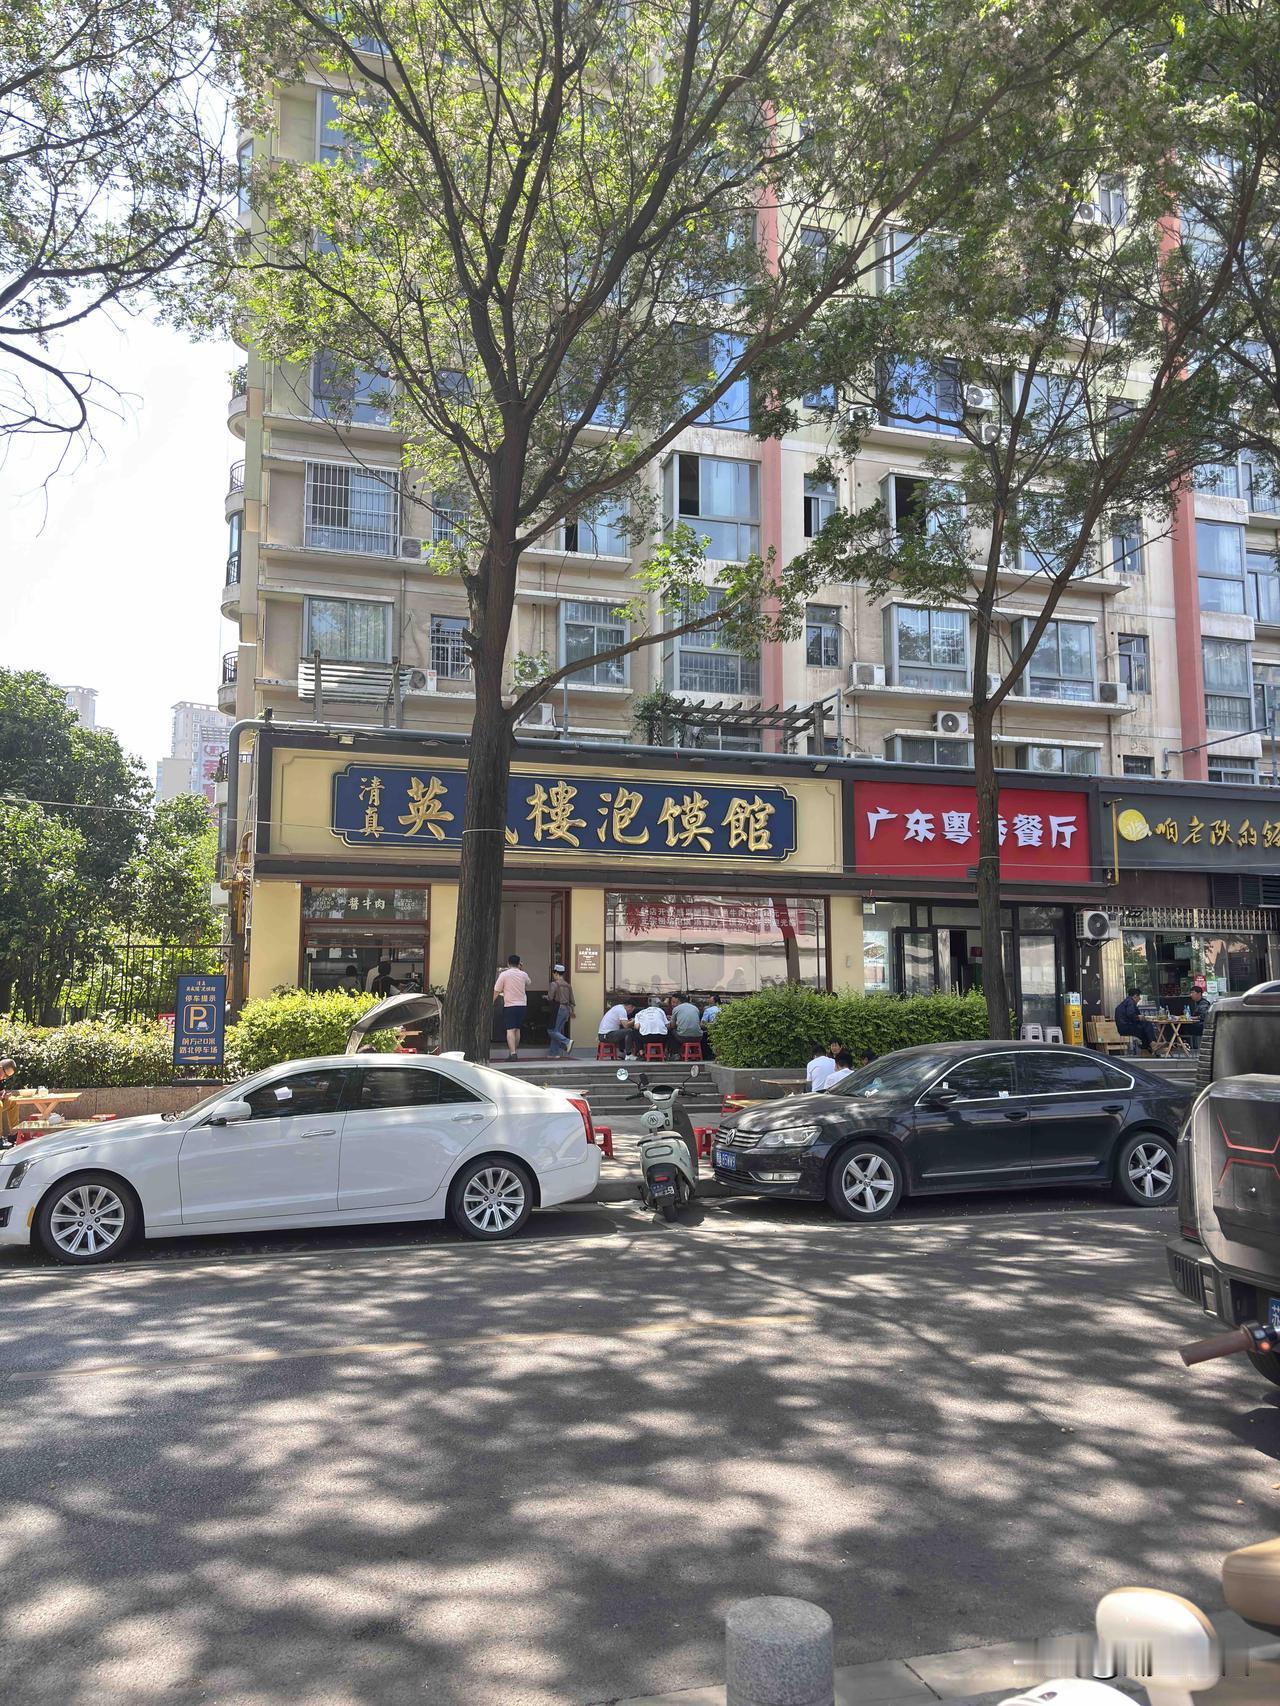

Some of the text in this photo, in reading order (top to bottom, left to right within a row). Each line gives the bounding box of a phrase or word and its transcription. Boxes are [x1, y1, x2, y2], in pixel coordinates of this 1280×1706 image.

[359, 776, 385, 838] 清真
[398, 776, 776, 852] 英樓泡馍館
[185, 994, 216, 1002] 停车提示
[189, 1006, 208, 1029] P
[179, 1046, 218, 1054] 路北停车场
